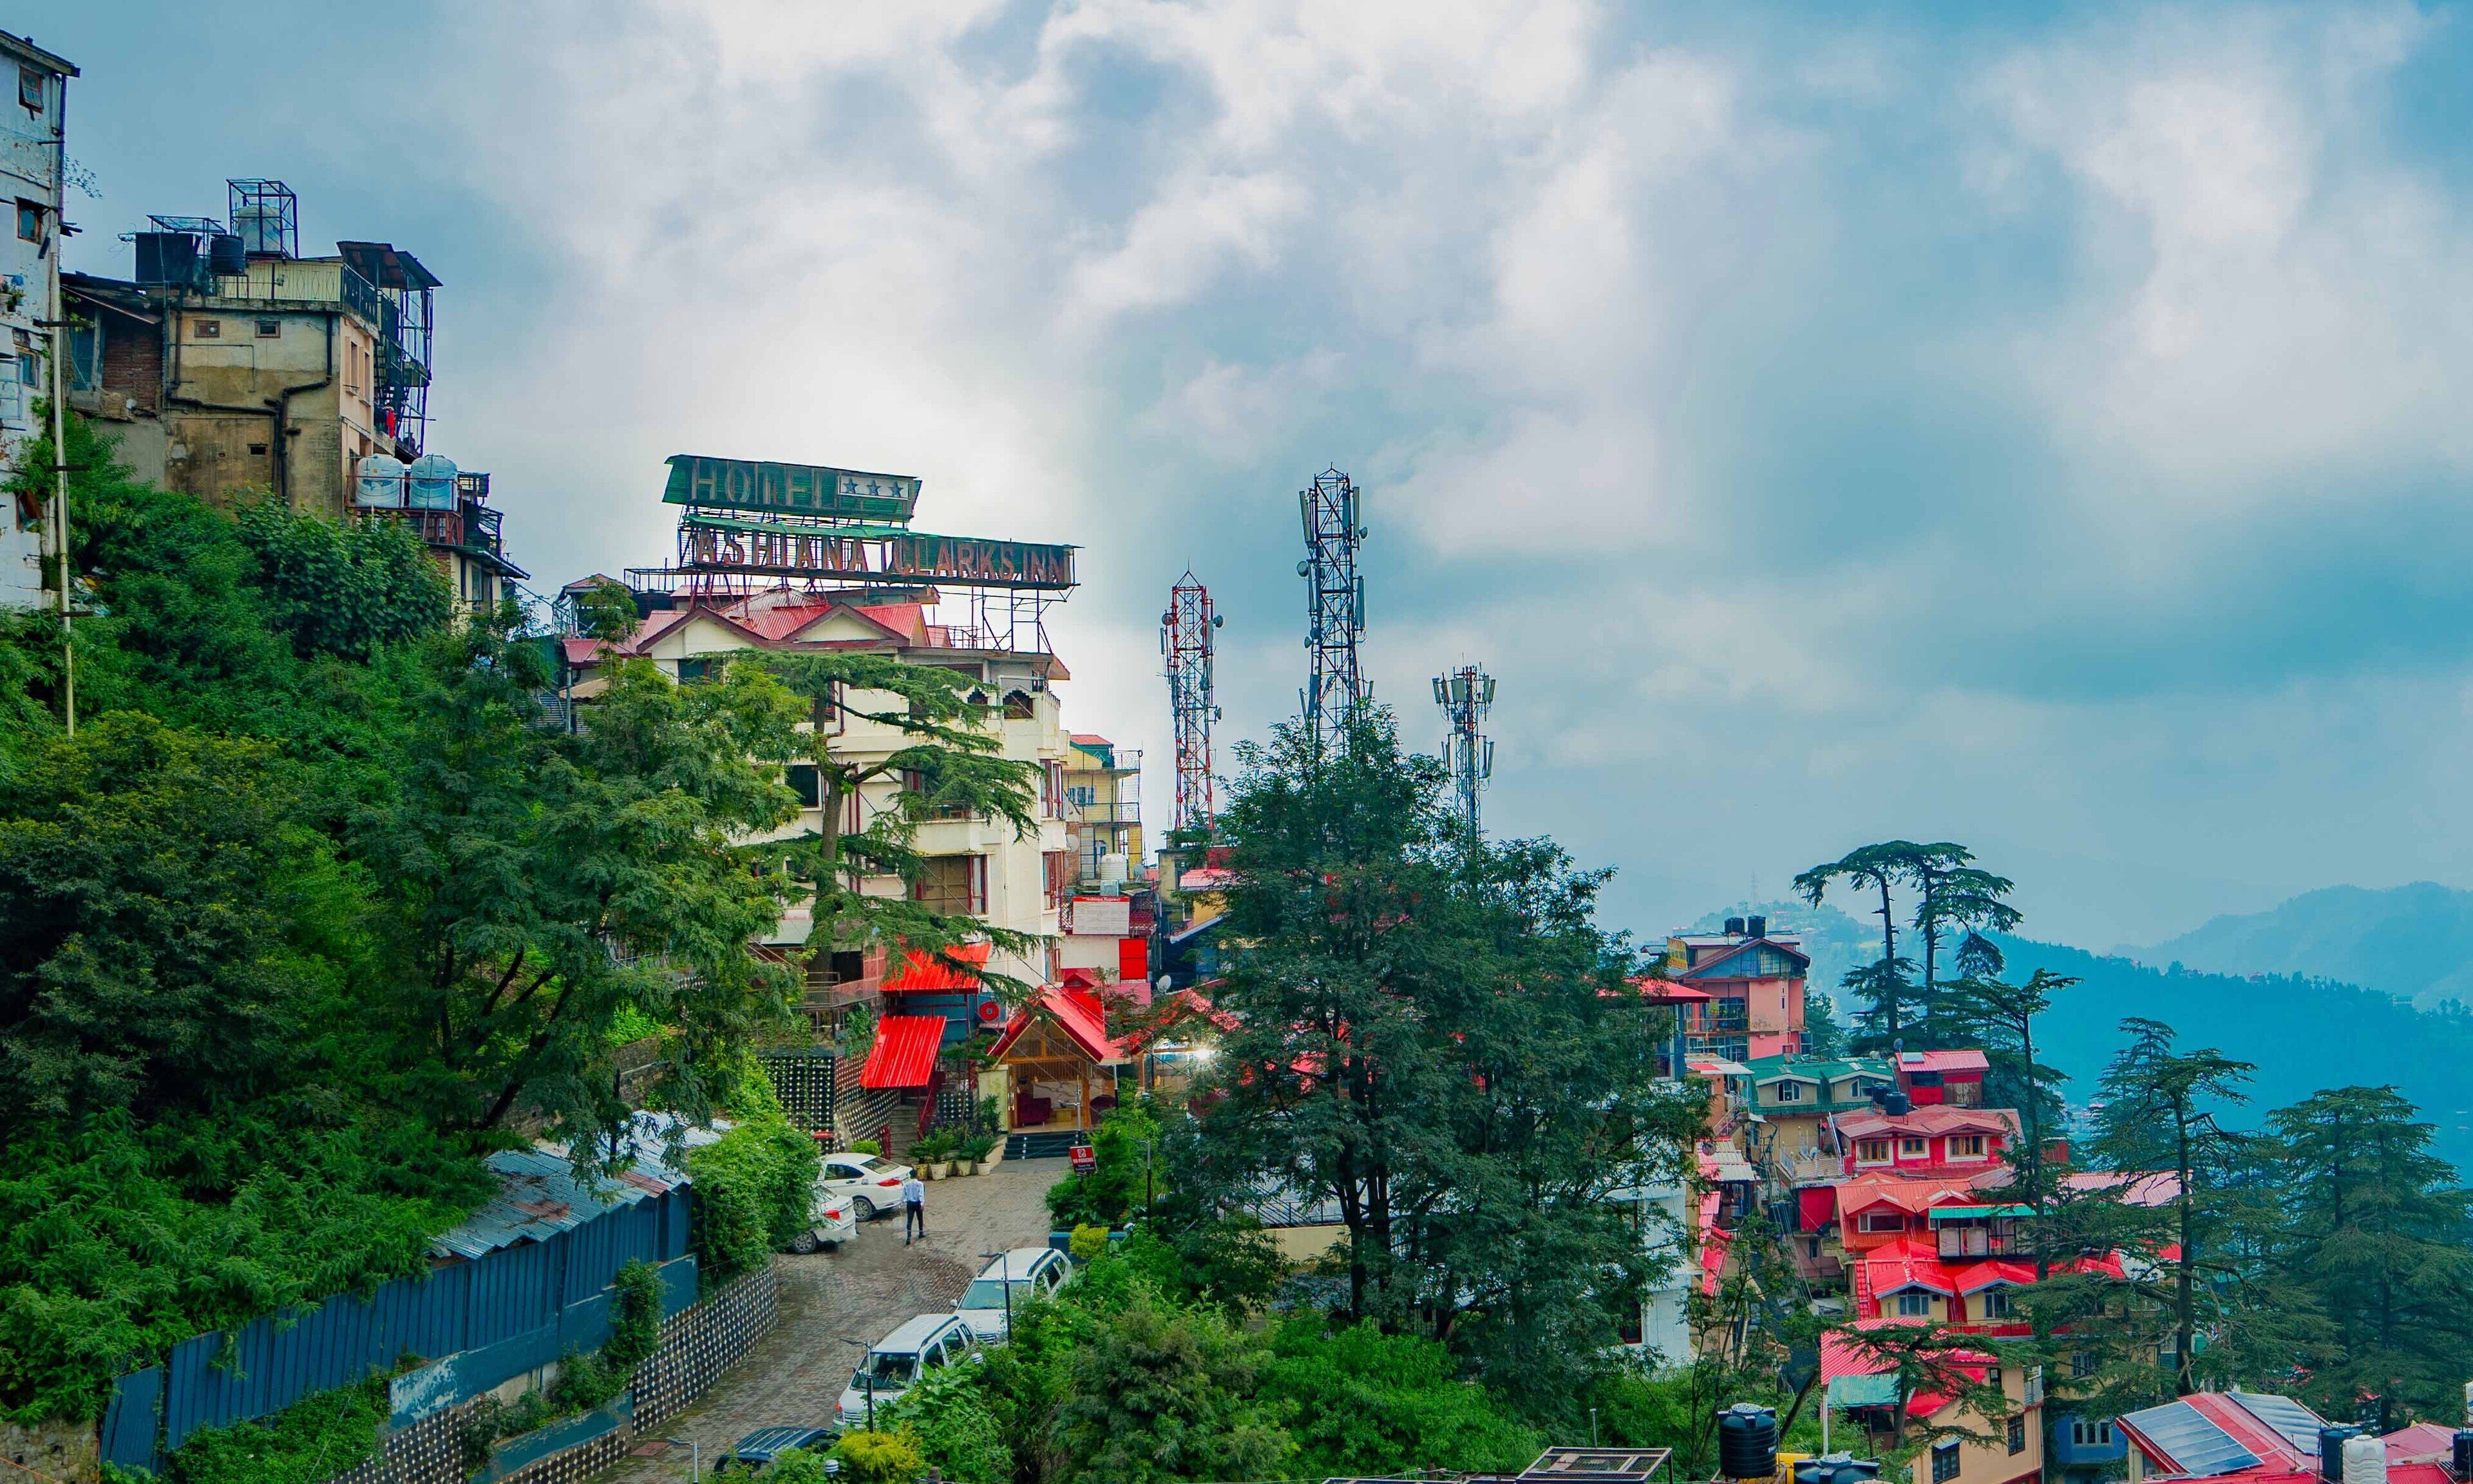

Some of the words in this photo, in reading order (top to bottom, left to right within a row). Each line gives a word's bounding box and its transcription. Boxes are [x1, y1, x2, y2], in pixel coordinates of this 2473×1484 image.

[697, 526, 869, 572] ASHIANA
[893, 534, 1015, 580] CLARKS
[1023, 544, 1068, 583] INN
